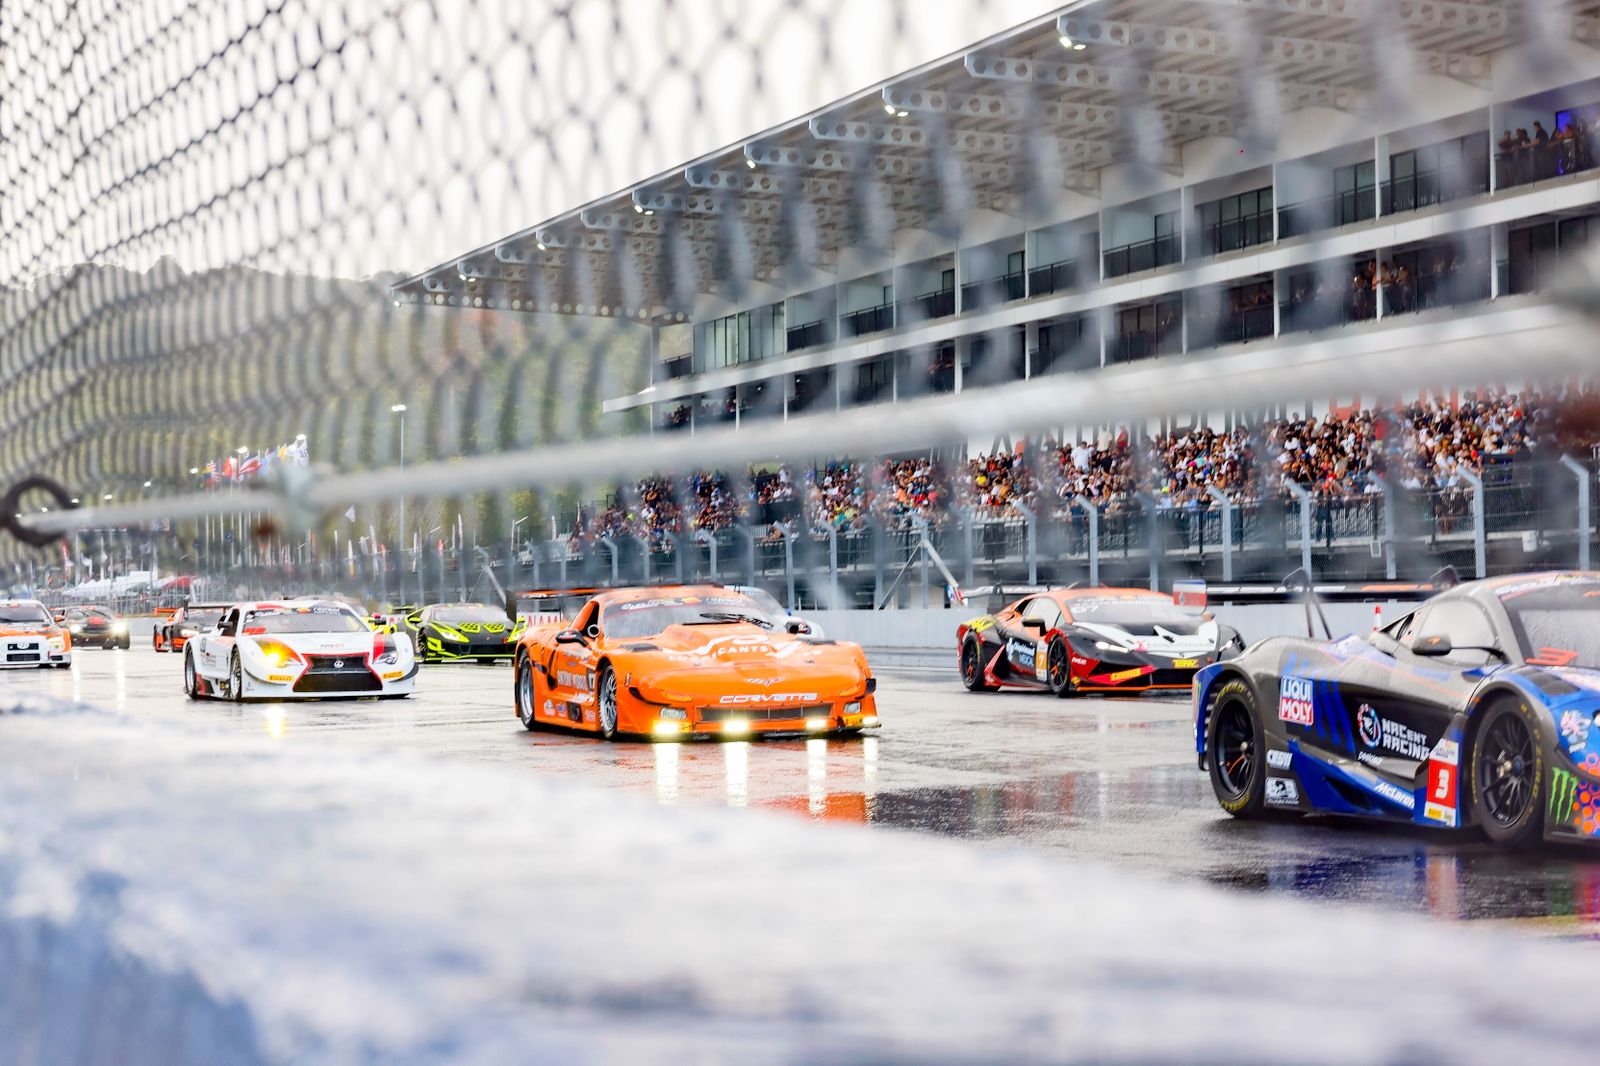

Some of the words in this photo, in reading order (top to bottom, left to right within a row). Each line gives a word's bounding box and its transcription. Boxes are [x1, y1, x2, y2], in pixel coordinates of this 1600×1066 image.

[719, 692, 818, 704] CORVETTE
[1282, 677, 1312, 700] LIQUI
[1280, 702, 1312, 724] MOLY
[1435, 768, 1450, 799] 3
[1374, 782, 1415, 810] McLaren
